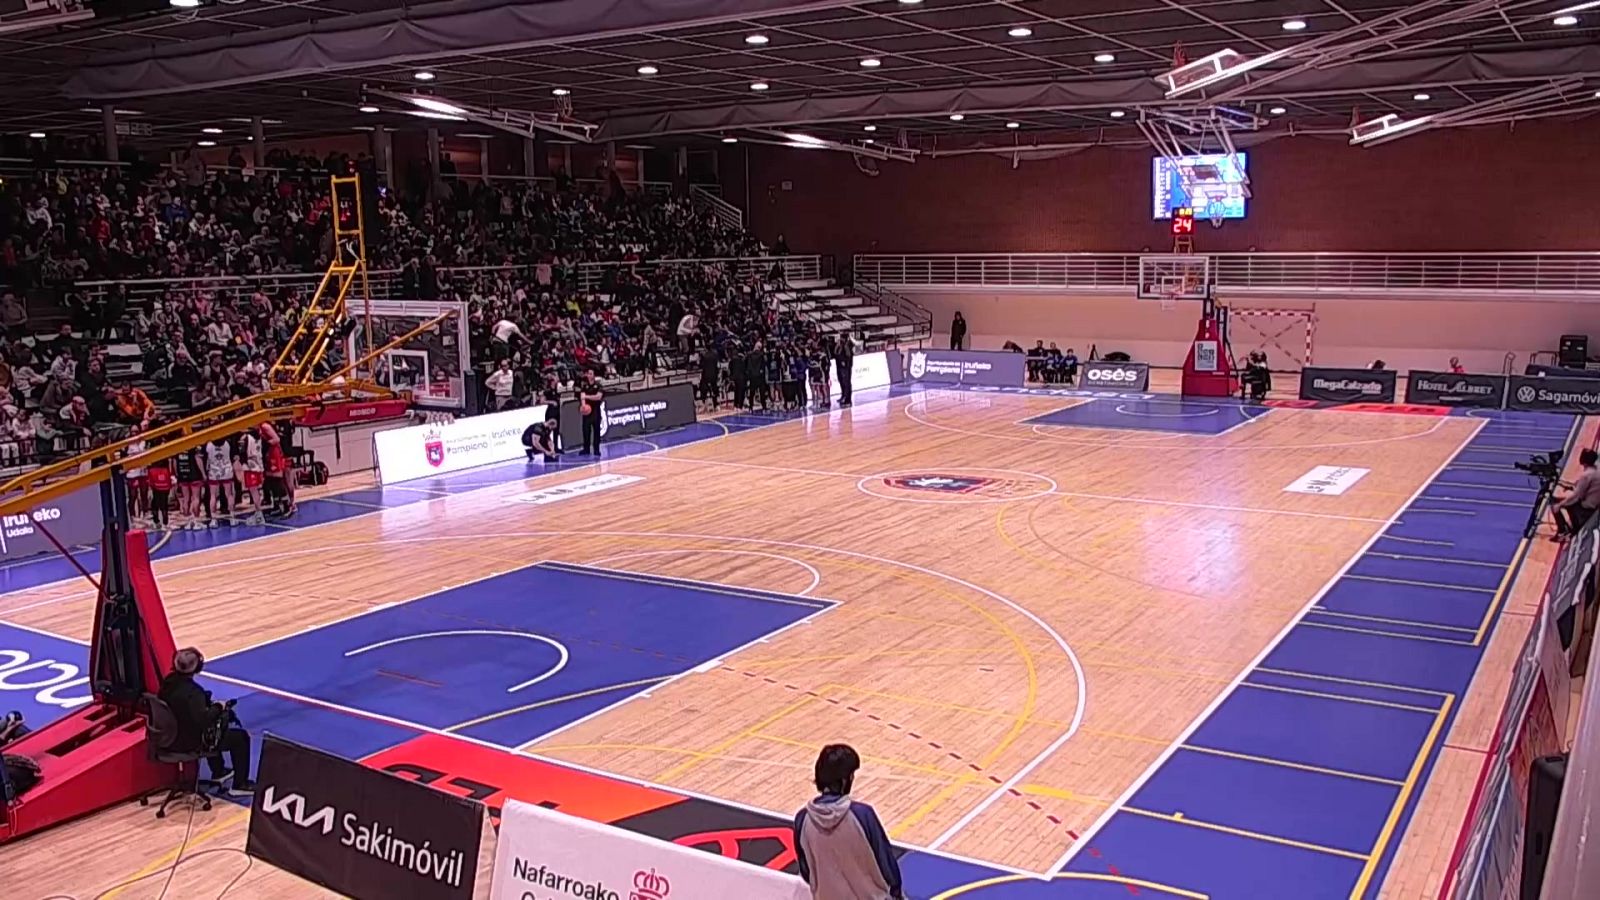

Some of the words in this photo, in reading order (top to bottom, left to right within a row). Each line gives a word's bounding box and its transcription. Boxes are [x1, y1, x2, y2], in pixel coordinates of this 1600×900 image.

[1173, 218, 1192, 233] 24
[1313, 378, 1382, 391] MegaCalzado
[340, 813, 464, 887] Sakimóvil
[512, 857, 619, 900] Nafarroako
